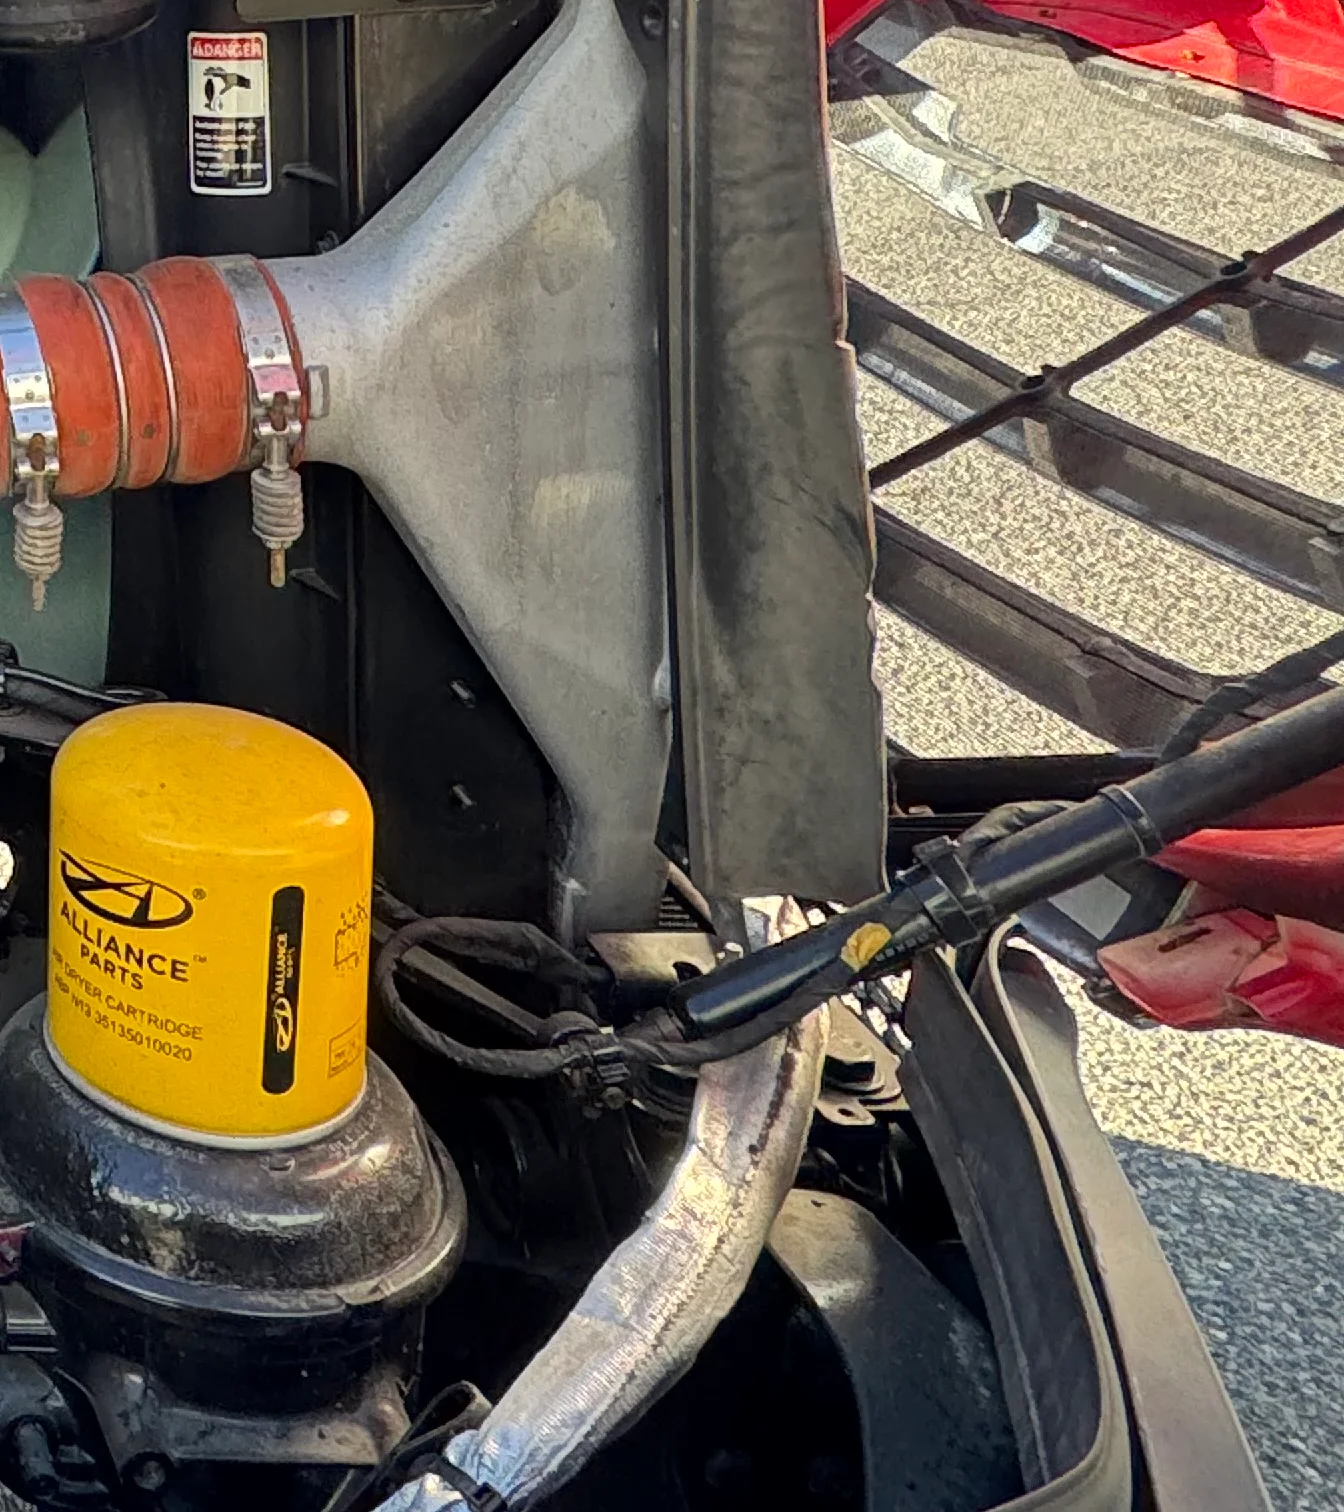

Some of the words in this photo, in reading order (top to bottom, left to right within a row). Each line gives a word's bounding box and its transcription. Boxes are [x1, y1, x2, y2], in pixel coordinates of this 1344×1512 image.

[203, 40, 262, 58] DANGER
[60, 900, 190, 983] ALLIANCE
[80, 942, 144, 990] PARTS
[64, 961, 103, 1004] DRYER
[105, 994, 204, 1041] CARTRIDGE
[94, 1009, 193, 1062] 35135010020
